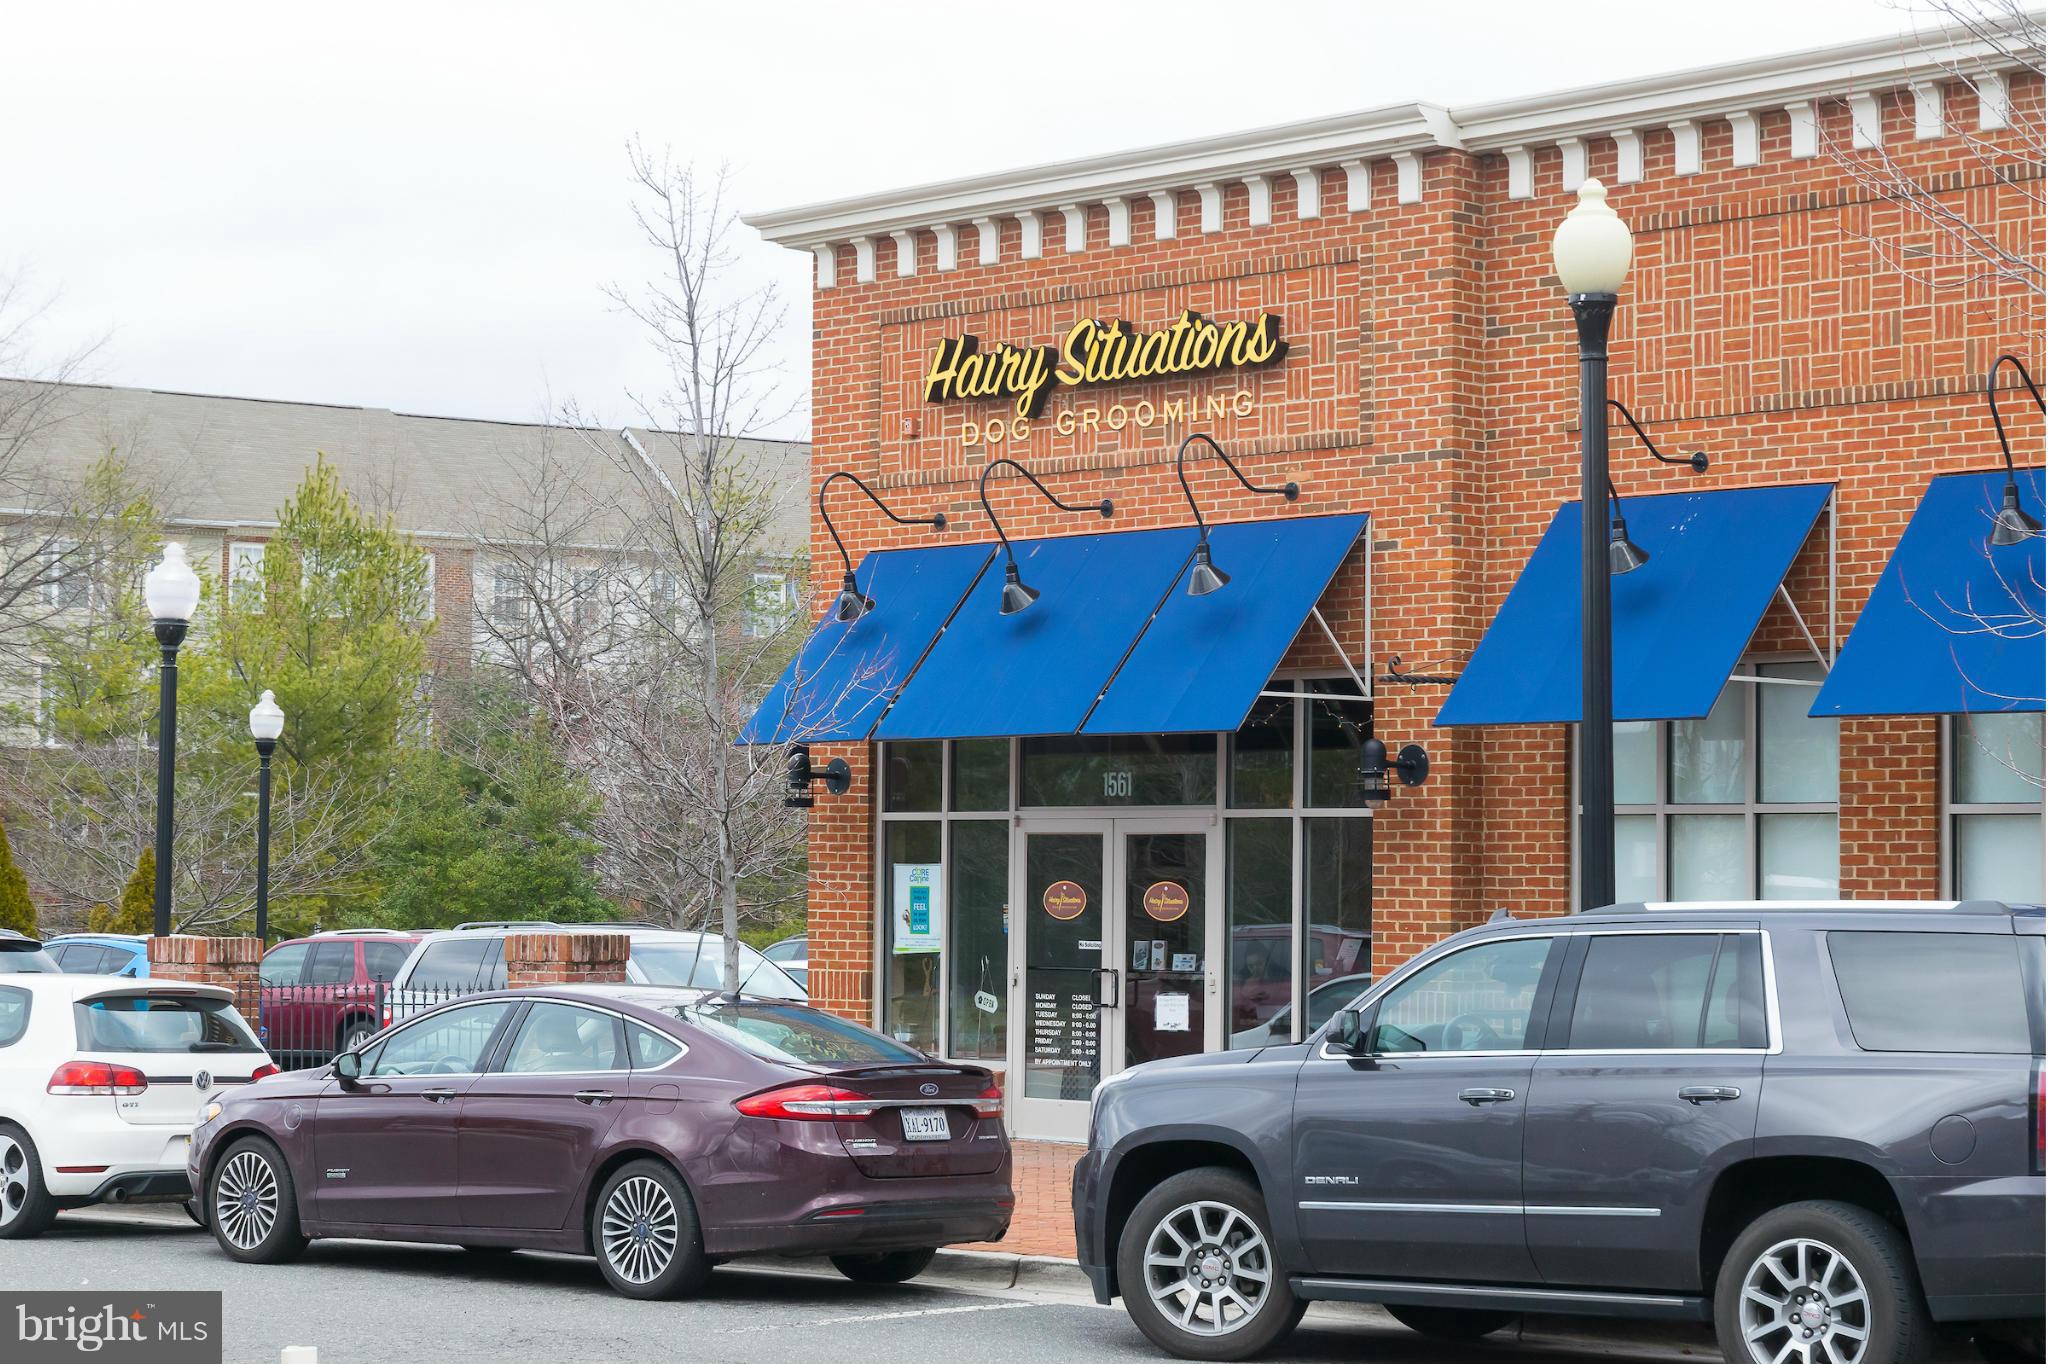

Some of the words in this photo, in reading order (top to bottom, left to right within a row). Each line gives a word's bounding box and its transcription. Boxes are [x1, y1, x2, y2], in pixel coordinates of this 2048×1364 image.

[925, 333, 1052, 418] Hairy
[1054, 308, 1284, 387] Situations
[961, 416, 1031, 447] DOG
[1056, 390, 1255, 437] GROOMING
[1102, 771, 1133, 797] 1561
[1034, 1019, 1067, 1027] WEDNESDAY
[1034, 1028, 1062, 1036] THURSDAY
[1034, 1046, 1061, 1054] SATURDAY
[1042, 1058, 1077, 1066] APPOINTMENT
[904, 1116, 946, 1133] XAL-9170
[1304, 1176, 1359, 1184] DENALI
